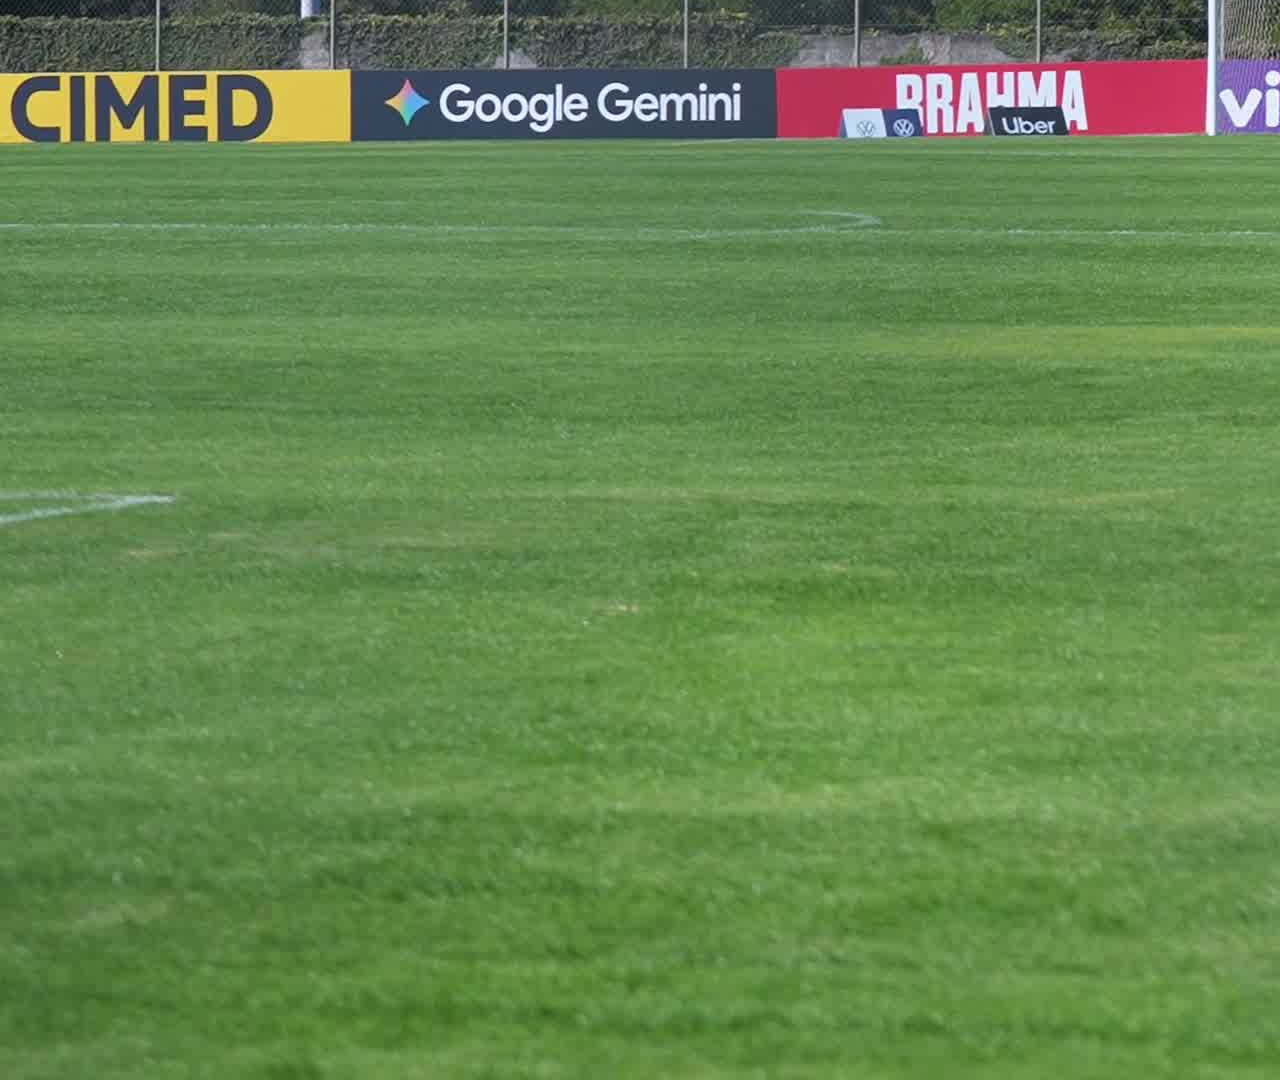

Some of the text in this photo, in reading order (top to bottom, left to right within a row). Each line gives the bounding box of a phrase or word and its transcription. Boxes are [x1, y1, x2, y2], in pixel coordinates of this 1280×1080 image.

[11, 75, 273, 142] CIMED
[439, 82, 742, 133] Google Gemini
[1002, 117, 1056, 134] Uber
